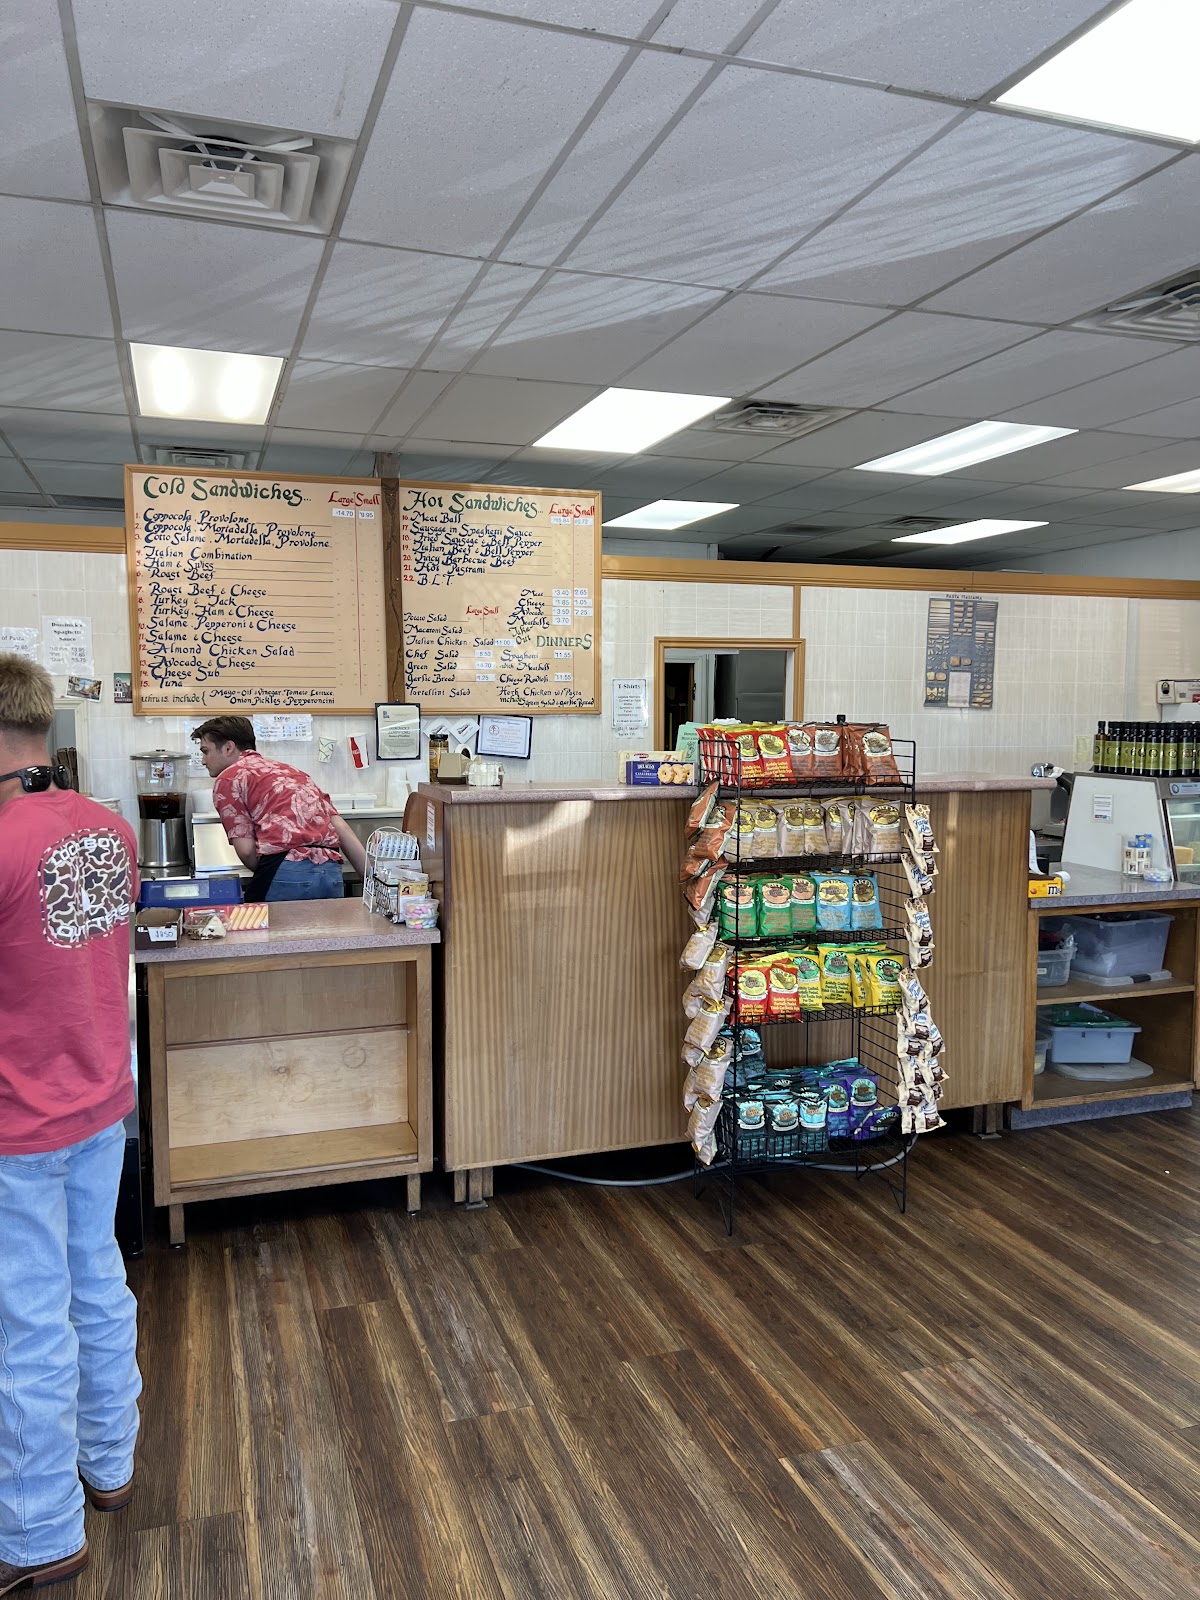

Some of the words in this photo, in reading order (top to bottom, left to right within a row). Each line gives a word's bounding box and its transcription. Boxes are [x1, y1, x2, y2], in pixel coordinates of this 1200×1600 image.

[143, 476, 185, 498] Cold
[328, 491, 354, 506] Large
[354, 492, 380, 506] Small
[403, 490, 443, 510] Hot
[197, 510, 248, 524] Provolone
[411, 510, 438, 522] Meat
[440, 512, 464, 523] Ball
[549, 503, 573, 517] Large
[574, 504, 594, 518] Small
[410, 521, 446, 535] Sausage
[459, 523, 502, 537] Spaghetti
[506, 525, 532, 539] Sauce
[275, 535, 330, 549] Provolone
[414, 532, 438, 544] Fried
[441, 533, 478, 546] Sausage
[511, 536, 542, 548] Pepper
[144, 546, 183, 558] Italian
[190, 546, 252, 560] Combination
[443, 544, 472, 556] Beef
[480, 546, 502, 557] Bell
[502, 546, 534, 558] Pepper
[144, 557, 172, 568] Ham
[184, 559, 214, 572] Swiss
[414, 552, 440, 564] Juicy
[442, 554, 486, 566] Barbecue
[490, 556, 516, 568] Beef
[148, 567, 180, 580] Roast
[187, 568, 215, 581] Beef
[414, 562, 440, 572] Hot
[448, 562, 486, 576] Pastrami
[149, 582, 182, 595] Roast
[188, 583, 217, 596] Beef
[230, 584, 266, 598] Cheese
[150, 594, 188, 608] Turkey
[207, 594, 236, 606] Jack
[150, 604, 189, 618] Turkey
[194, 606, 224, 617] Ham
[236, 605, 274, 618] Cheese
[426, 613, 447, 622] Salad
[146, 616, 188, 629] Salame
[194, 616, 246, 630] Pepperoni
[256, 618, 296, 632] Cheese
[404, 624, 440, 634] Macaroni
[441, 626, 462, 636] Salad
[146, 630, 187, 642] Salame
[201, 630, 242, 644] Cheese
[406, 635, 434, 646] Italian
[437, 636, 468, 646] Chicken
[472, 638, 494, 648] Salad
[536, 634, 592, 650] DINNERS
[147, 642, 201, 654] Almond
[209, 644, 257, 656] Chicken
[260, 645, 294, 658] Salad
[405, 649, 430, 660] Chef
[434, 650, 459, 660] Salad
[148, 655, 201, 668] Avocado
[216, 656, 256, 670] Cheese
[434, 662, 457, 672] Salad
[151, 666, 192, 680] Cheese
[196, 666, 220, 681] Sub
[432, 674, 456, 683] Bread
[156, 676, 183, 688] Tuna
[406, 686, 445, 696] Tortellini
[449, 688, 470, 698] Salad
[523, 686, 552, 696] Chicken
[83, 837, 120, 849] BOY
